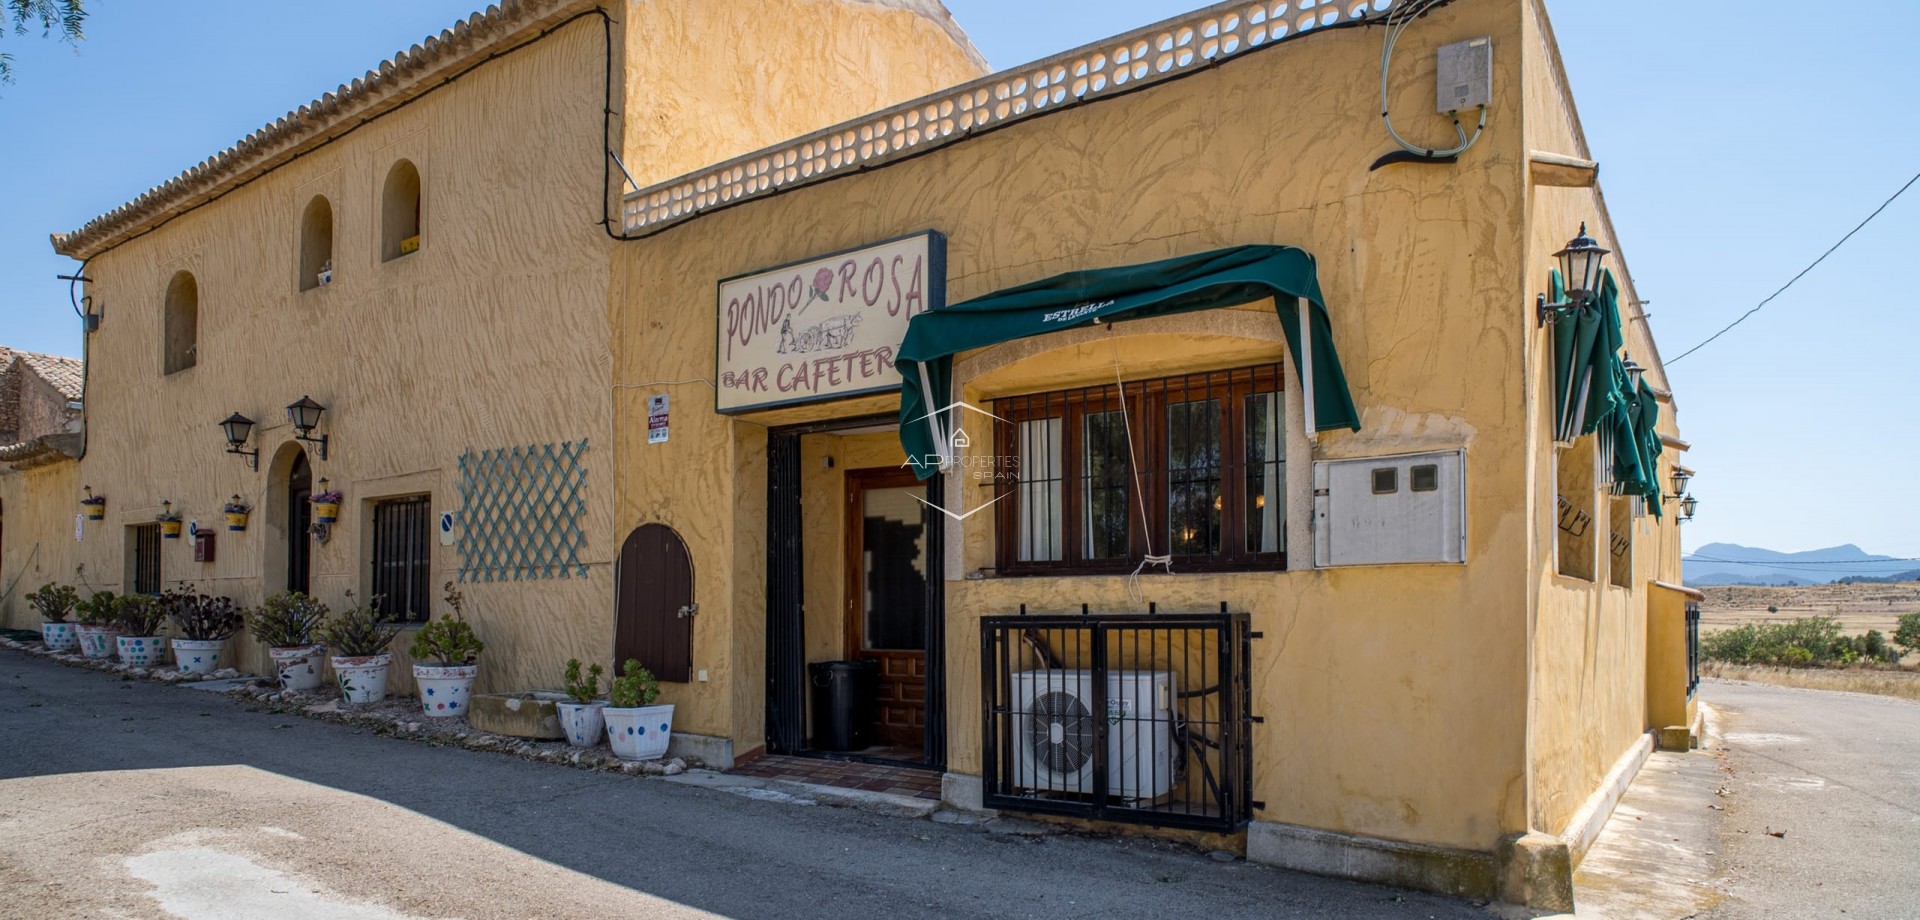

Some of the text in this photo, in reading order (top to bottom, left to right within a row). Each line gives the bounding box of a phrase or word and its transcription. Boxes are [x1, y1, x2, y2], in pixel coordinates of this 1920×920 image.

[727, 254, 923, 361] PONDO ROSA
[1042, 300, 1115, 322] ESTRELLA
[721, 344, 901, 393] BAR CAFETER
